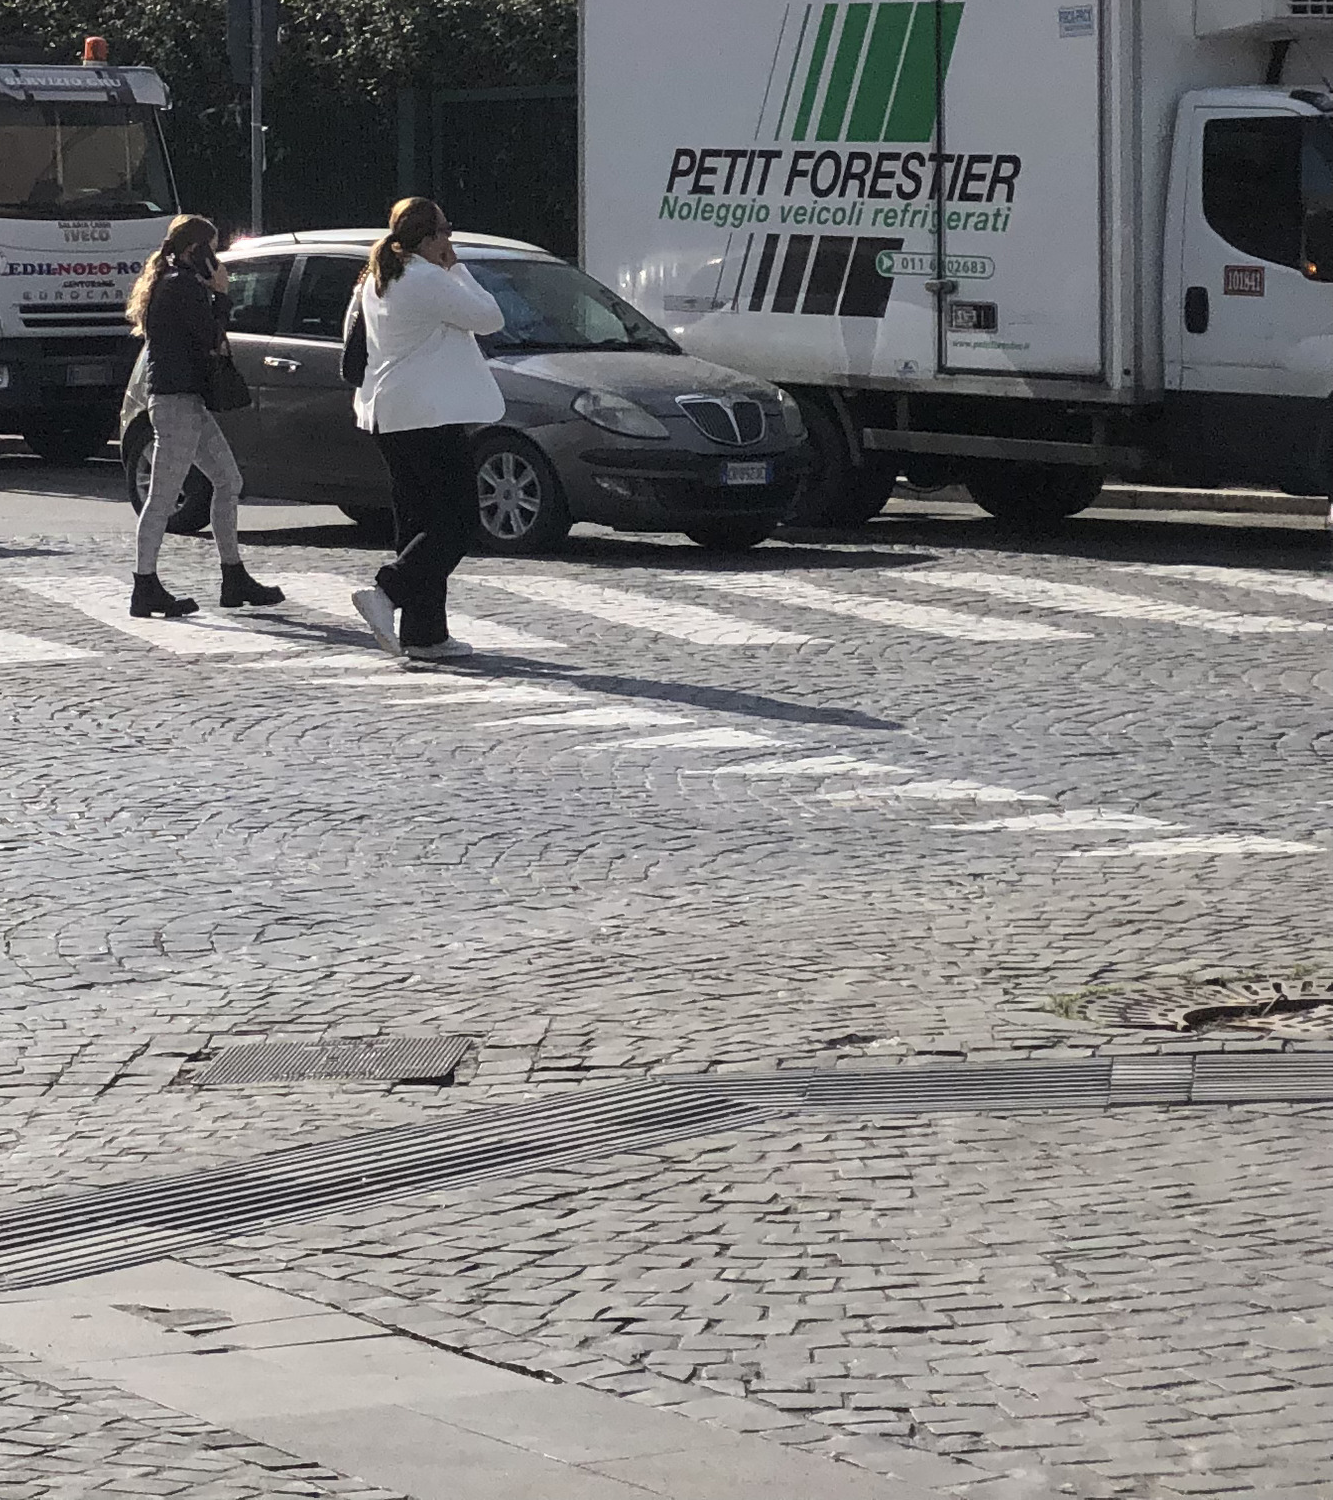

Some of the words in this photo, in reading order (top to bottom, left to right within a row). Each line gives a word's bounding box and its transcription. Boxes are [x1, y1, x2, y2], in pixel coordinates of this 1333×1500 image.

[4, 76, 82, 86] SERVIZIO
[88, 77, 122, 88] GRU
[666, 148, 783, 196] PETIT
[784, 149, 1022, 203] FORESTIER
[658, 195, 770, 229] Noleggio
[780, 199, 866, 228] veicoli
[871, 203, 1012, 233] refrigerati
[63, 229, 111, 242] IVECO
[901, 257, 924, 271] 011
[1228, 270, 1261, 292] 101841
[23, 289, 123, 301] EUROCAR
